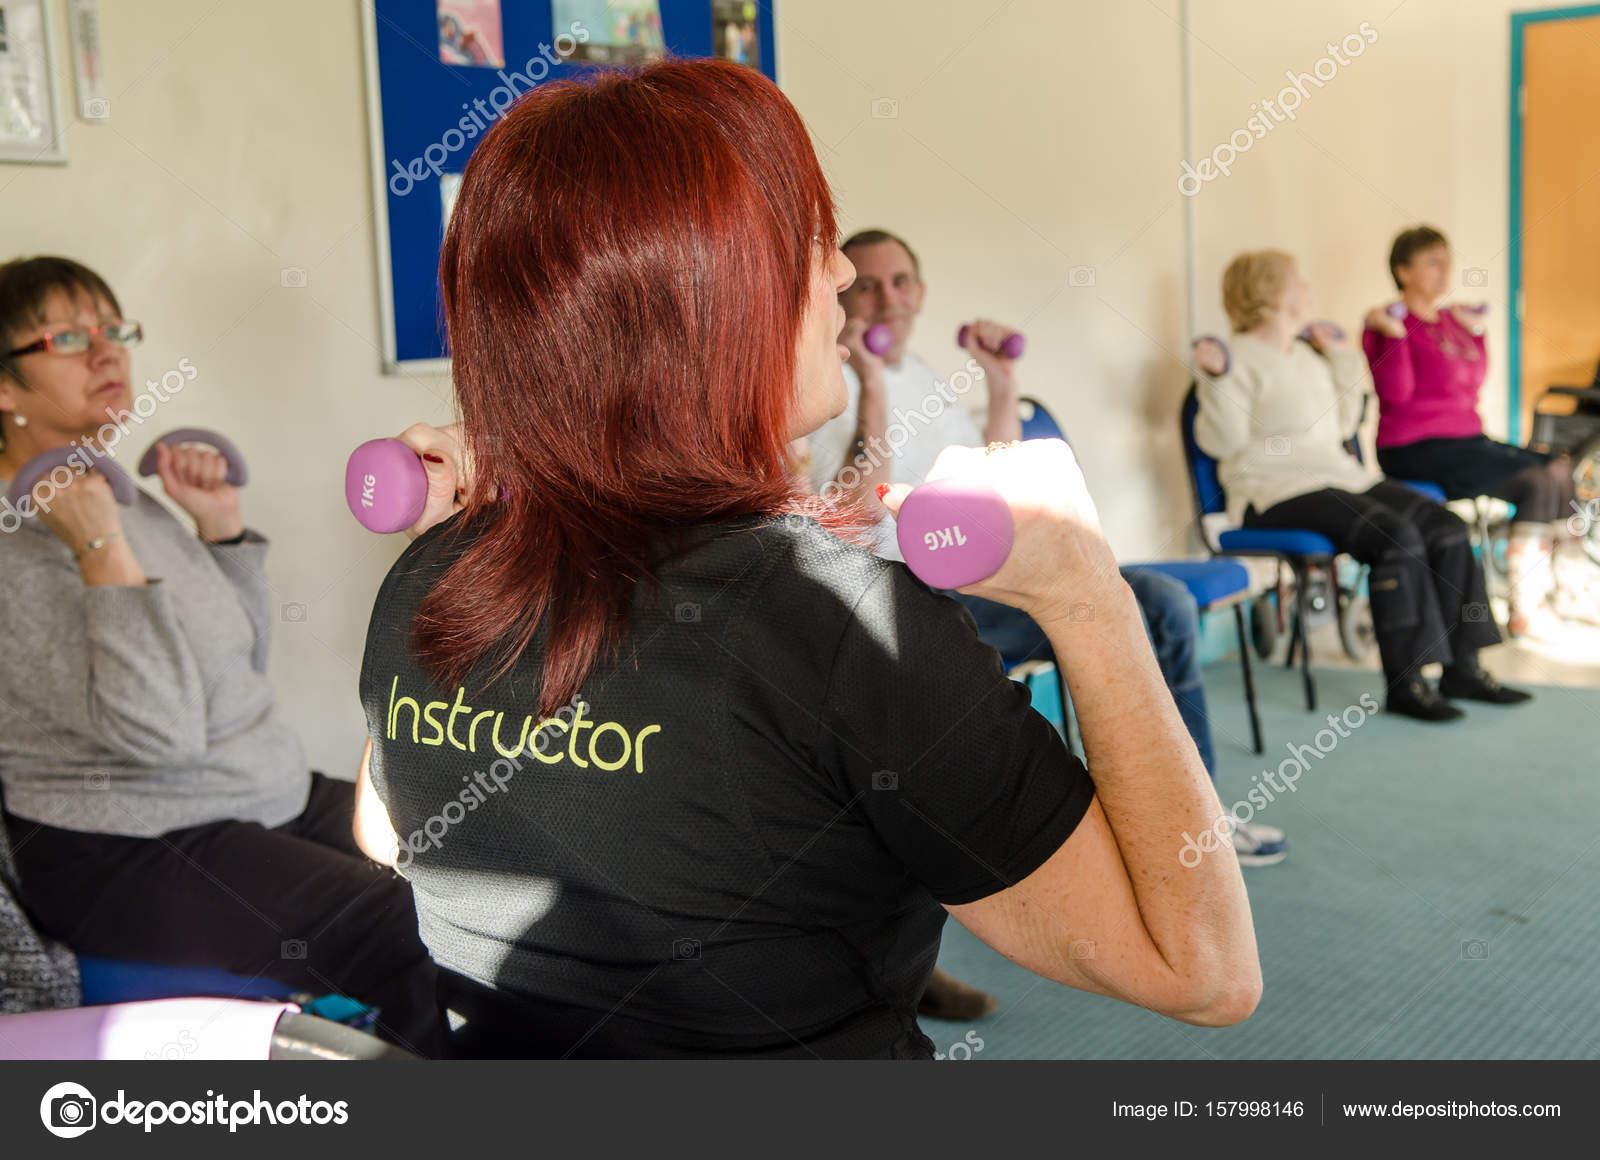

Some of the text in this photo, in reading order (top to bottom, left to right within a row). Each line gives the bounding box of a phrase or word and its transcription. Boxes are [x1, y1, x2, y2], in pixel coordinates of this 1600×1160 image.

[361, 474, 376, 508] 1KG
[923, 525, 968, 551] 1KG
[387, 675, 662, 774] Instructor
